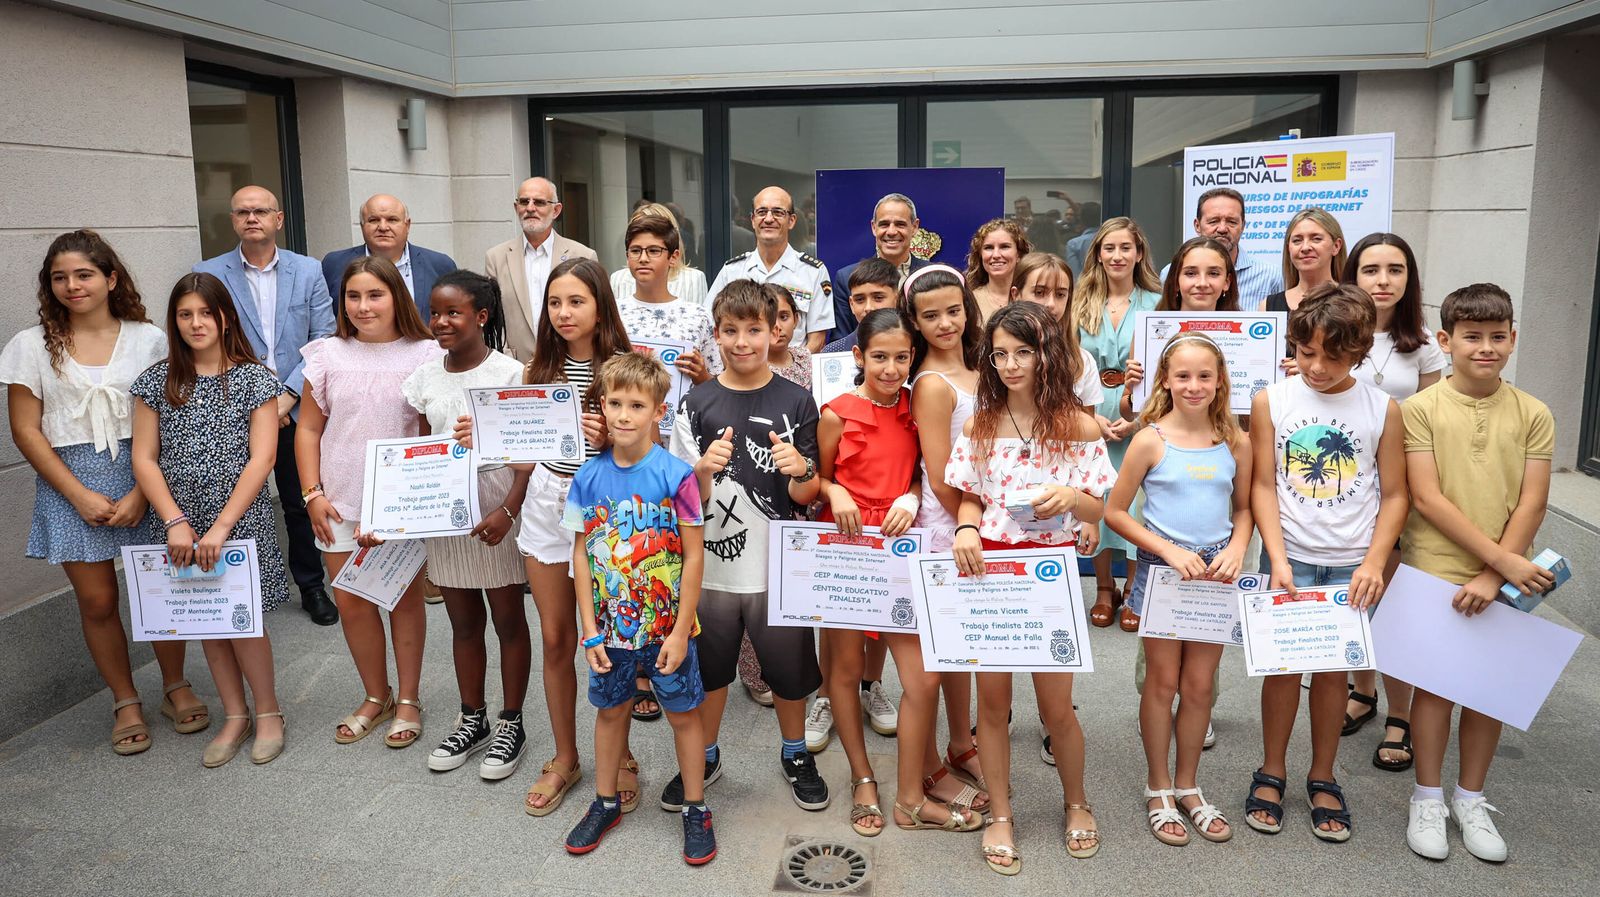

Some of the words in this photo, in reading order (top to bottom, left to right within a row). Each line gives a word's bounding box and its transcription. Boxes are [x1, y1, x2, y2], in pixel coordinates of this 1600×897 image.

[1193, 170, 1287, 186] NACIONAL
[1273, 192, 1288, 201] DE
[1290, 187, 1368, 200] INFOGRAFÍAS
[1287, 204, 1304, 213] DE
[1305, 202, 1363, 212] INTERNET
[1188, 322, 1233, 331] DIPLOMA
[1278, 417, 1318, 449] MALIBU
[1331, 419, 1363, 454] BEACH
[411, 444, 443, 456] DIPLOMA
[1317, 472, 1364, 507] SUMMER
[833, 573, 858, 581] Manuel
[860, 574, 868, 582] de
[812, 585, 842, 593] CENTRO
[845, 587, 889, 596] EDUCATIVO
[189, 598, 212, 606] finalista
[828, 595, 872, 604] FINALISTA
[971, 607, 999, 615] Martina
[1194, 610, 1217, 618] finalista
[960, 622, 990, 631] Trabajo
[1024, 633, 1042, 641] Falla
